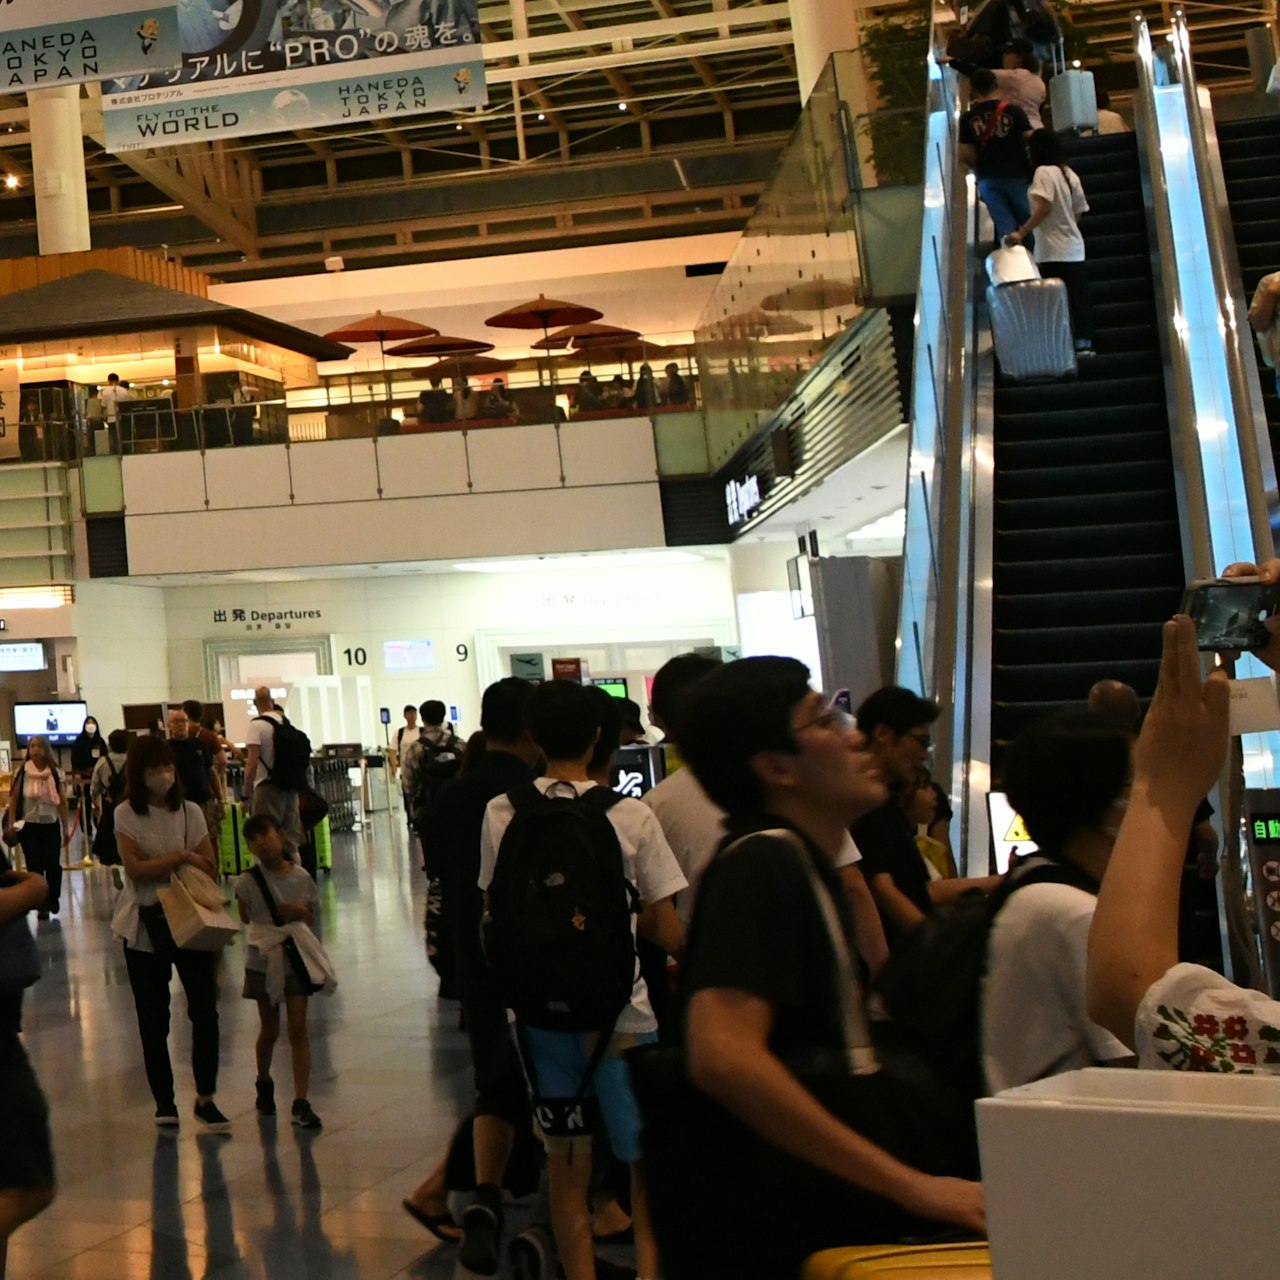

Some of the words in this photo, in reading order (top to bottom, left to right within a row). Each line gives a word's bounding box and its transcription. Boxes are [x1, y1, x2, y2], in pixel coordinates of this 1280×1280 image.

[339, 76, 424, 96] HANEDA
[340, 87, 426, 107] TOKYO
[137, 112, 161, 123] FLY
[167, 108, 185, 119] TO
[191, 104, 220, 115] THE
[342, 98, 427, 118] JAPAN
[138, 112, 240, 137] WORLD
[214, 609, 246, 623] 出発
[250, 609, 322, 623] Departures
[343, 647, 368, 666] 10
[456, 643, 468, 663] 9
